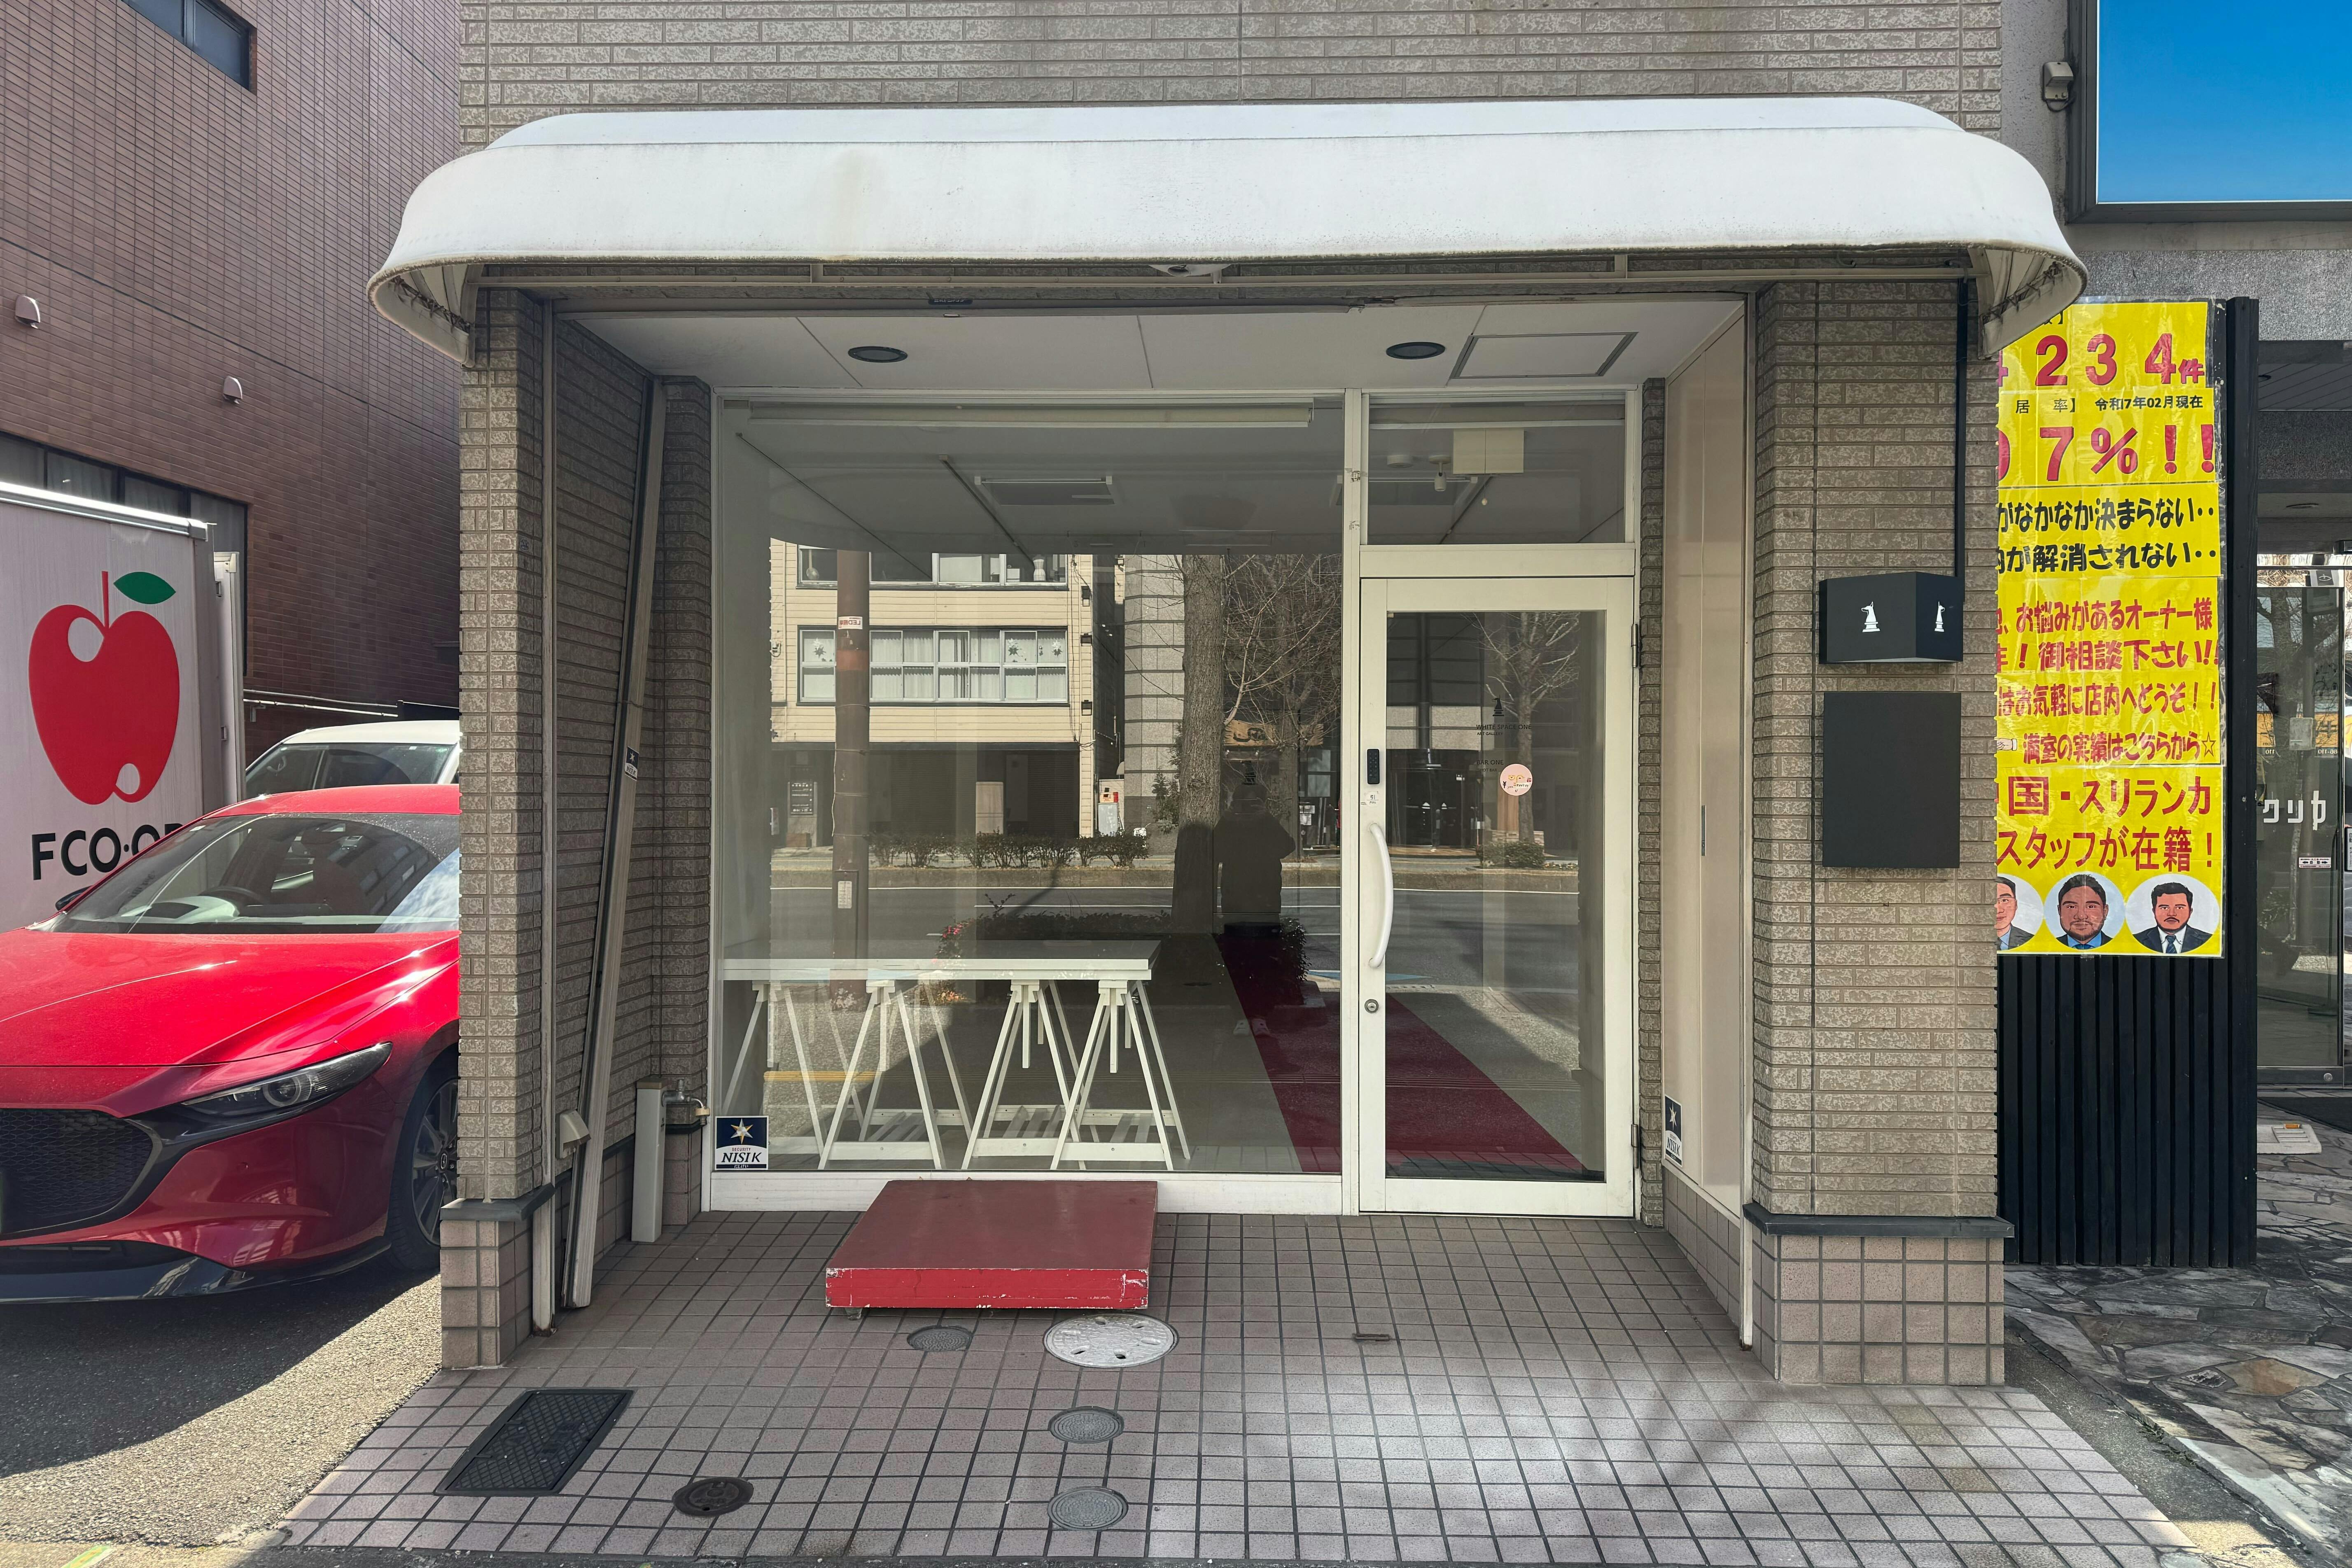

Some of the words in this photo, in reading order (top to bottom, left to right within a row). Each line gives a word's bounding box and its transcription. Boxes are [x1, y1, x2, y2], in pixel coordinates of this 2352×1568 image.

[2095, 395, 2203, 411] 令和7年02月現在
[1996, 776, 2212, 817] 国・スリランカ
[1667, 1137, 1680, 1156] NISIK
[721, 1153, 762, 1162] NISIK
